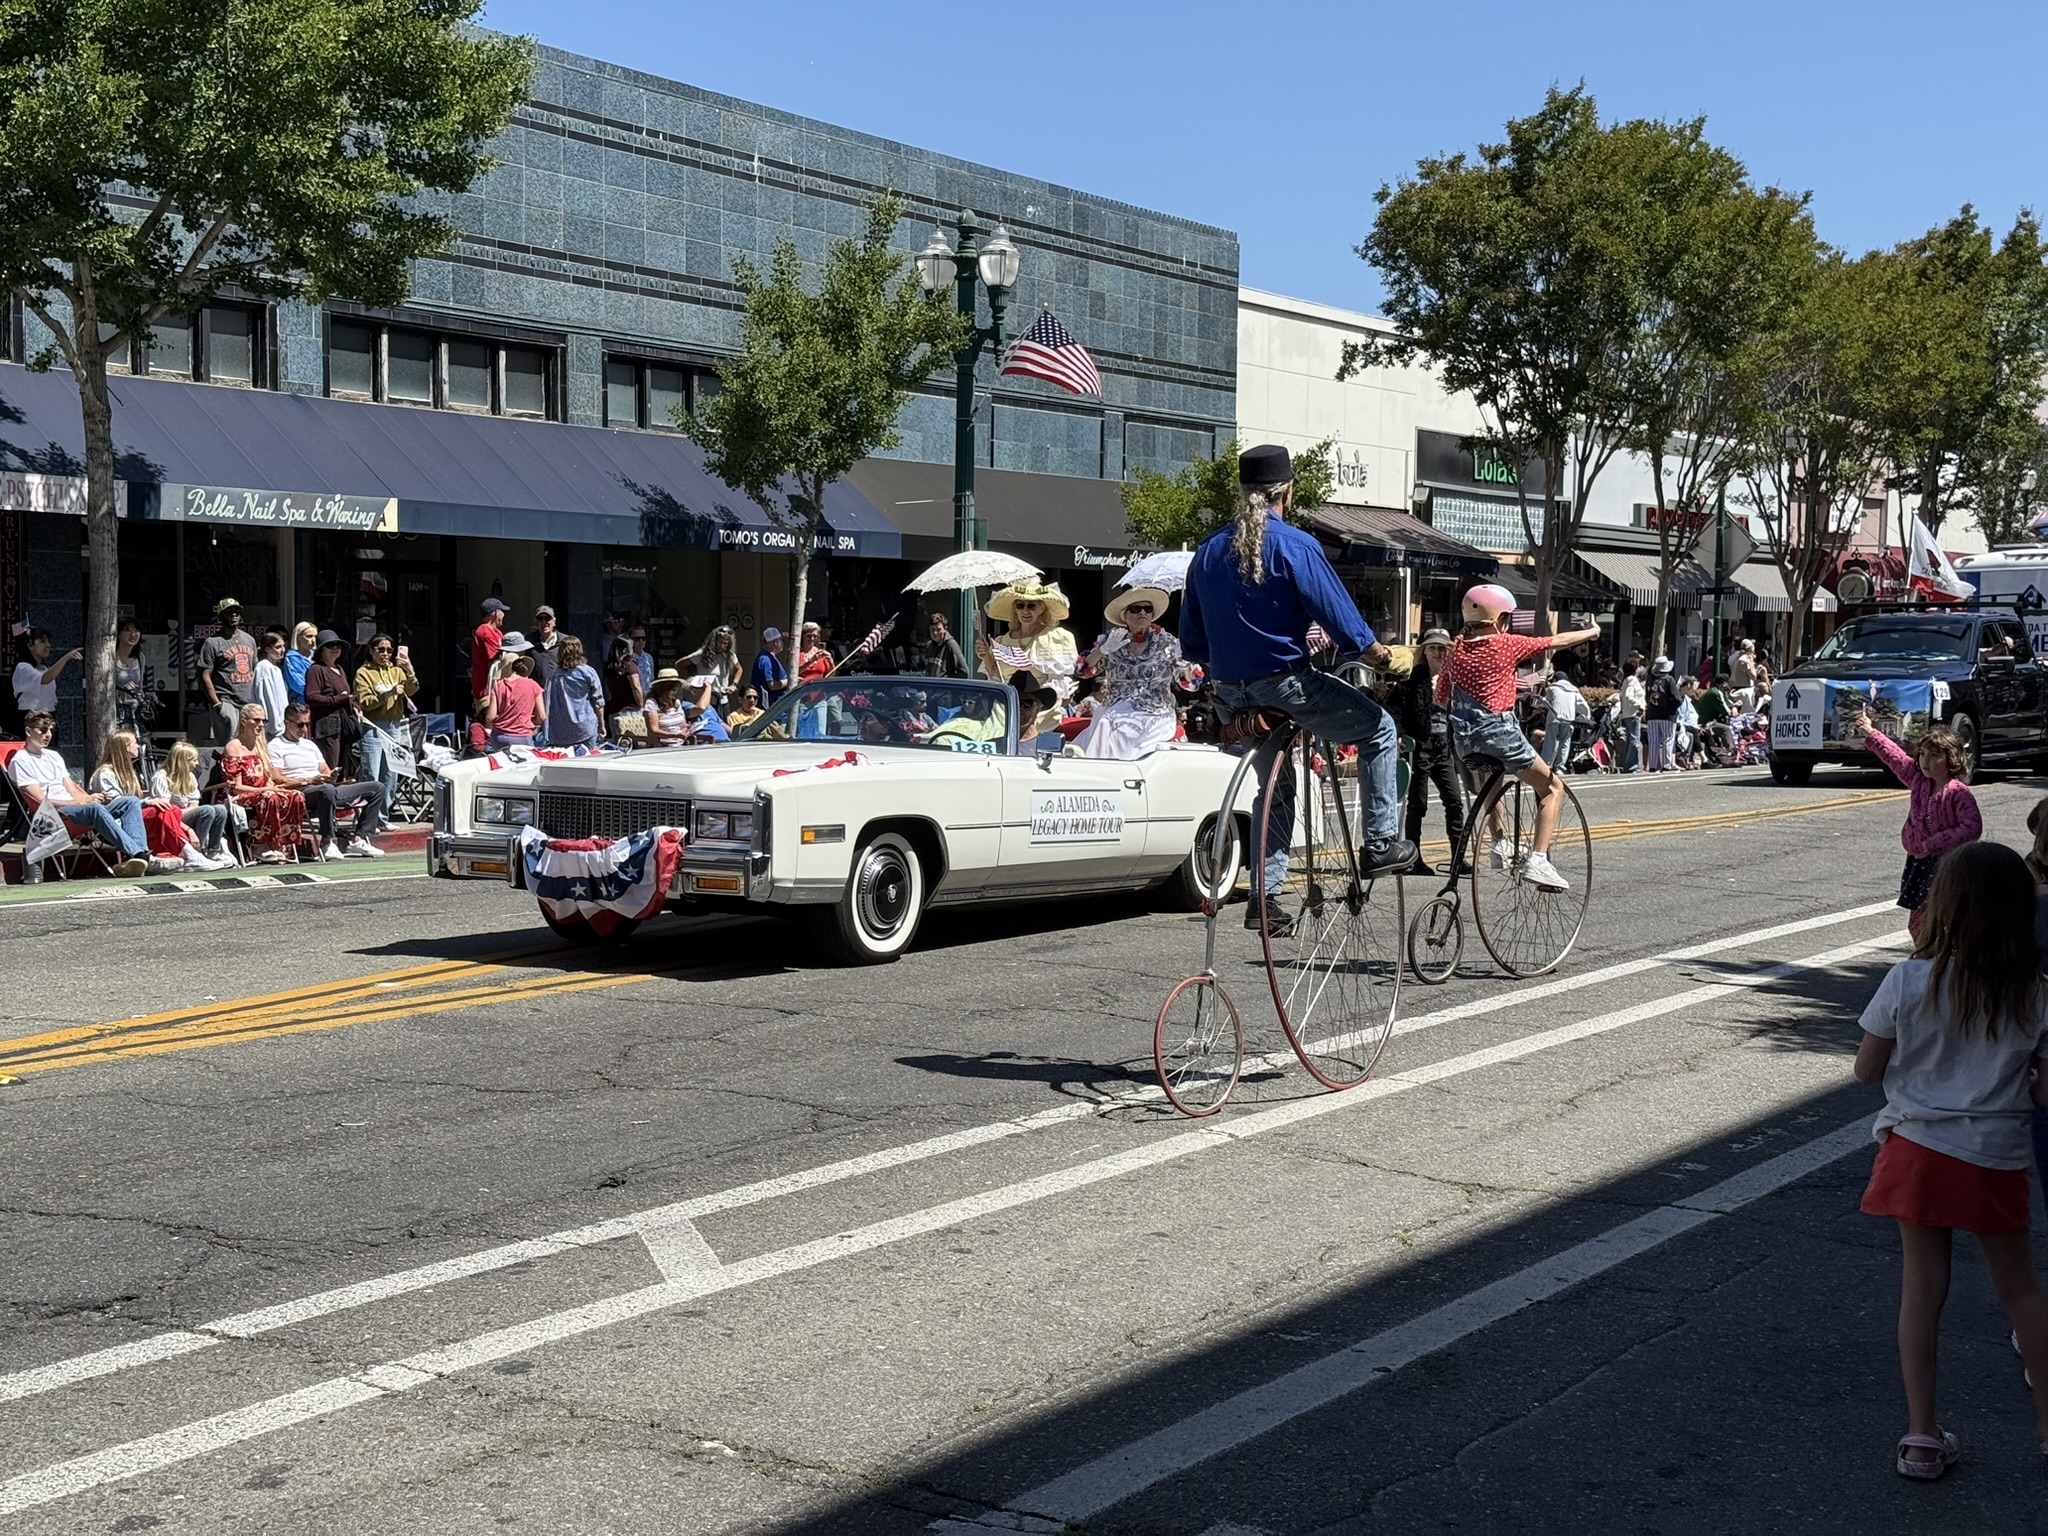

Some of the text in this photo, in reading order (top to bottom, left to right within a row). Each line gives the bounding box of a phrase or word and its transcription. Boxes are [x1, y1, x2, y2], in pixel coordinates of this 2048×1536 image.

[187, 488, 377, 530] Bella Nail Spa & Waxing
[719, 529, 759, 545] TOMO'S
[814, 535, 835, 549] NAIL
[838, 536, 856, 550] SPA
[1074, 545, 1126, 570] Triumphant
[1935, 685, 1949, 698] 129
[1776, 714, 1811, 722] ALAMEDA TINY
[1775, 722, 1811, 738] HOMES
[954, 741, 993, 755] 128
[1056, 796, 1101, 813] ALAMEDA
[1032, 816, 1124, 836] LEGACY HOME TOUR
